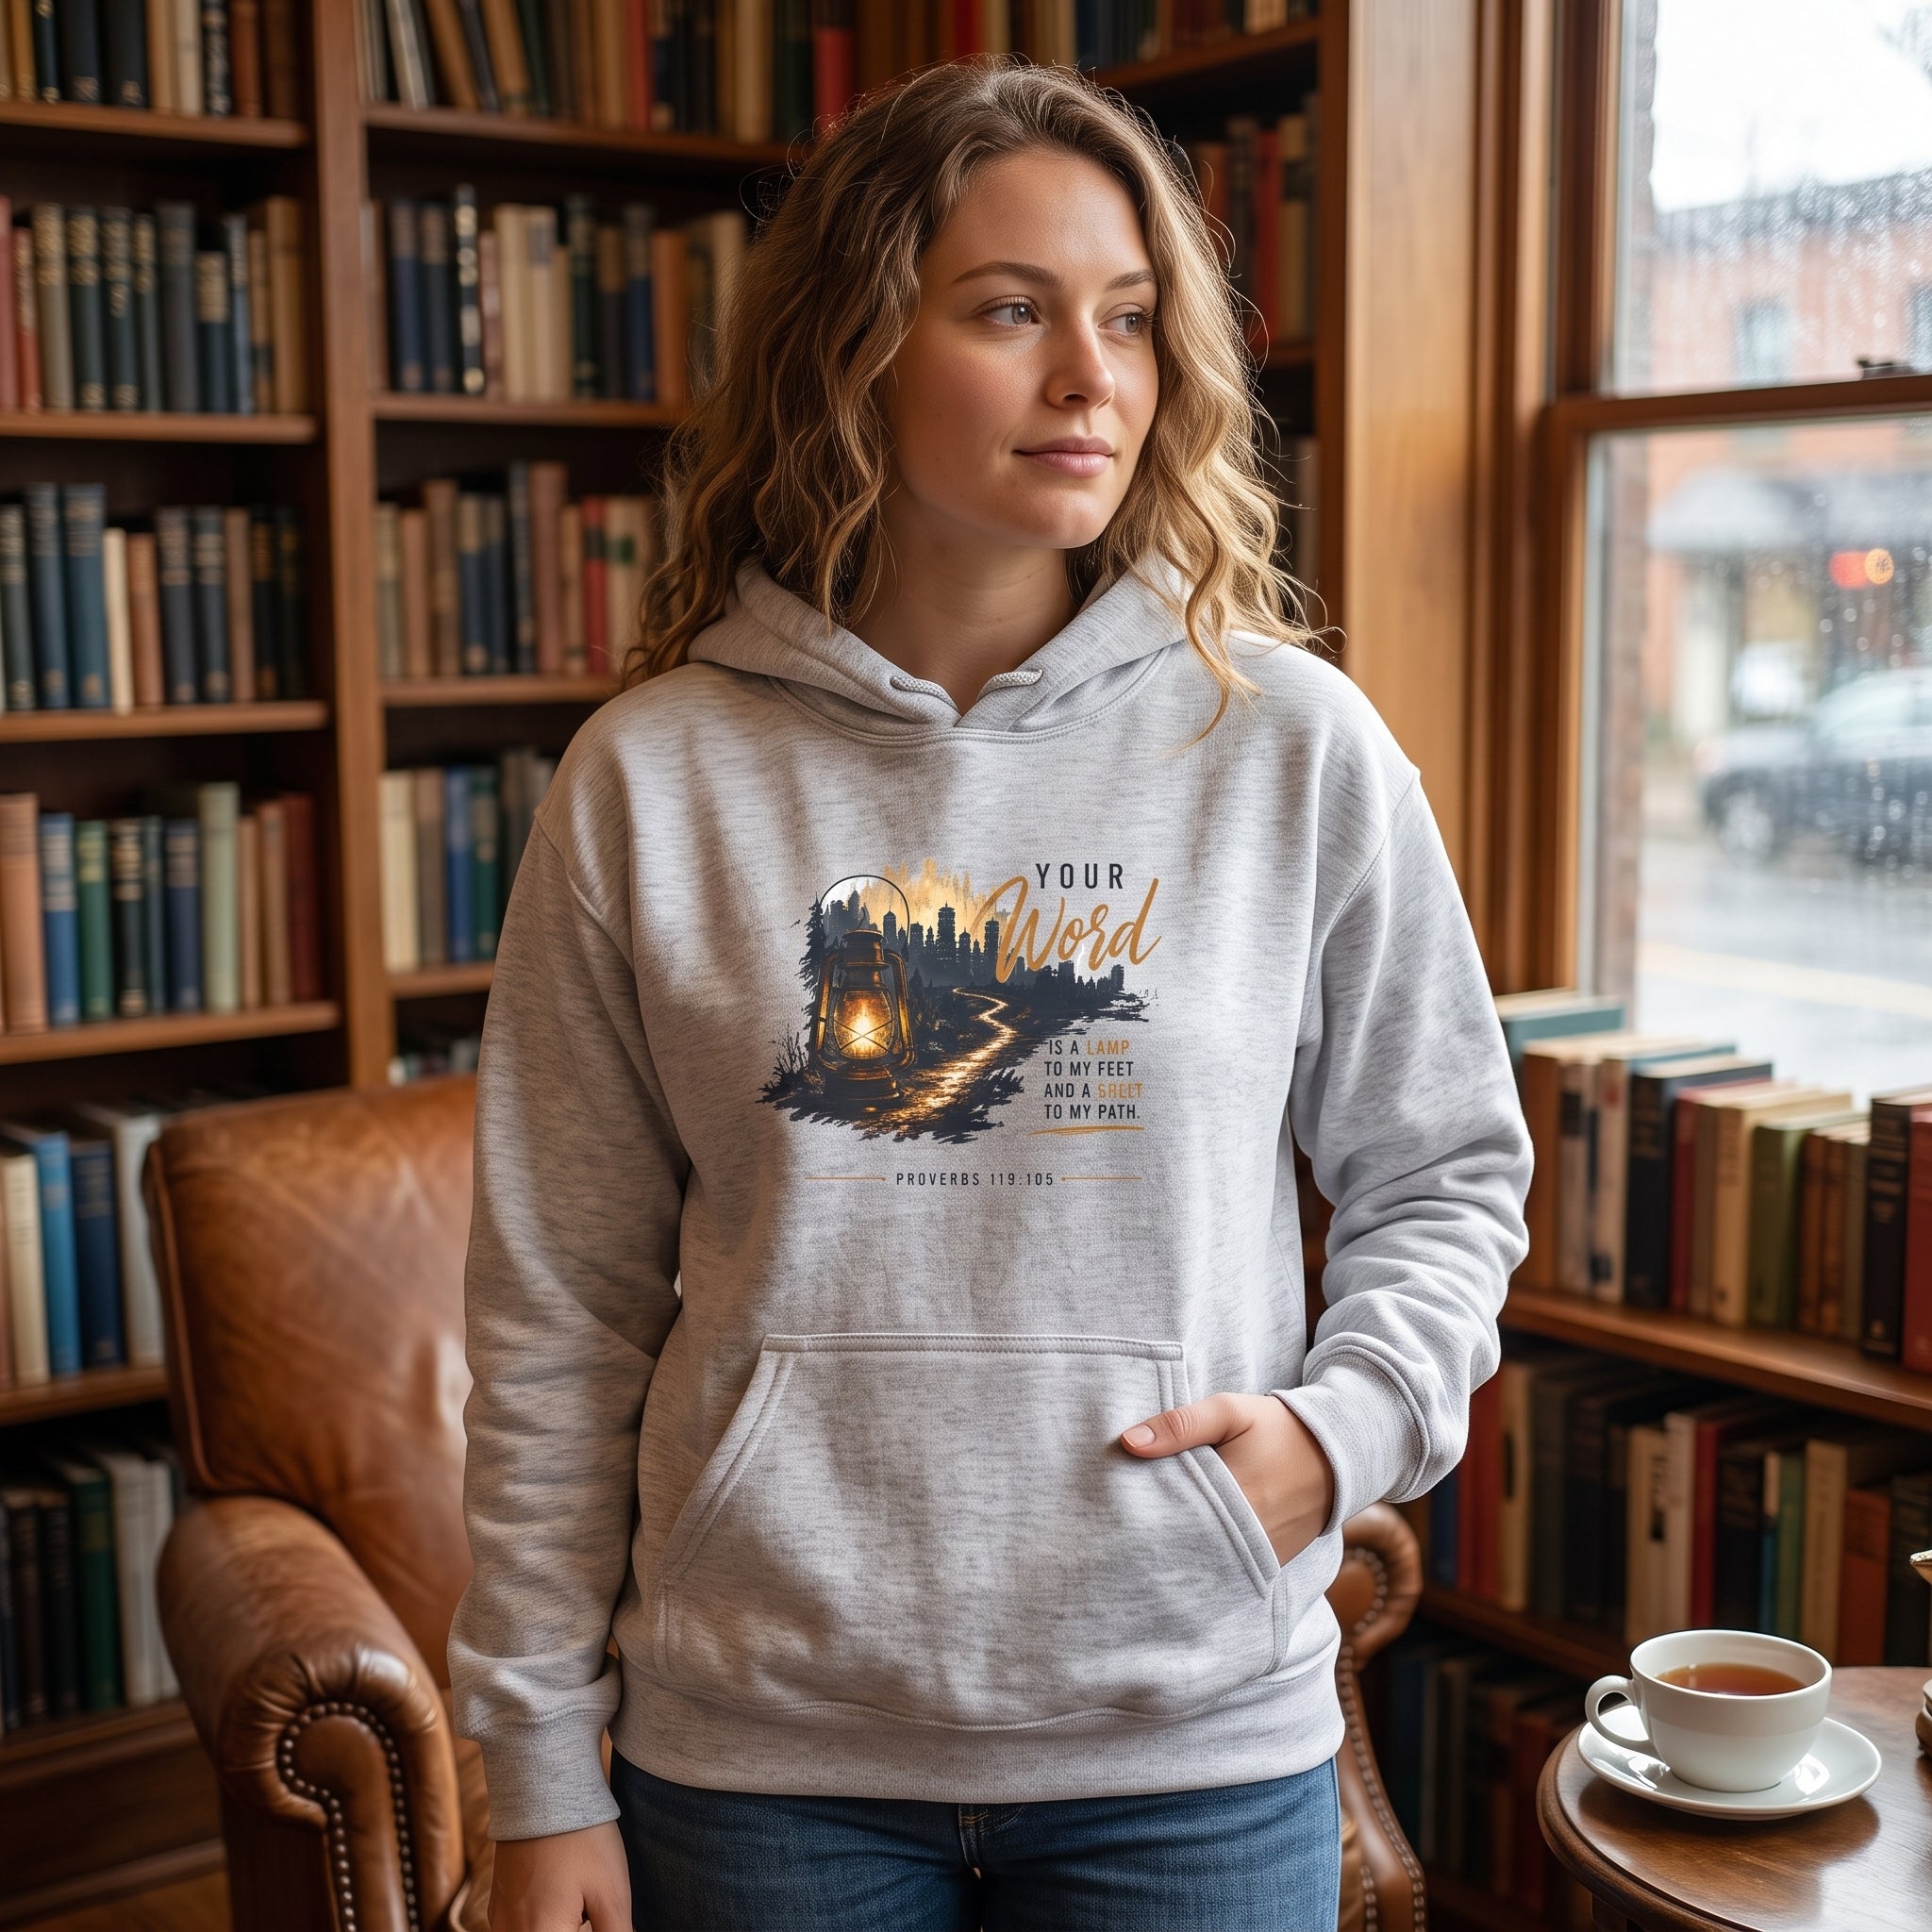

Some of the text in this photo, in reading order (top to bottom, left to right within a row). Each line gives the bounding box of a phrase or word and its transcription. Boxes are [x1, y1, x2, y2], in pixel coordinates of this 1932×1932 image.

[1036, 863, 1124, 889] YOUR
[971, 875, 1161, 984] Word
[1049, 1040, 1130, 1055] IS A LAMP
[1044, 1061, 1134, 1076] TO MY FEET
[1044, 1083, 1074, 1098] AND
[1081, 1083, 1091, 1098] A
[1044, 1104, 1140, 1120] TO MY PATH.
[896, 1173, 1055, 1186] PROVERBS 119:105
